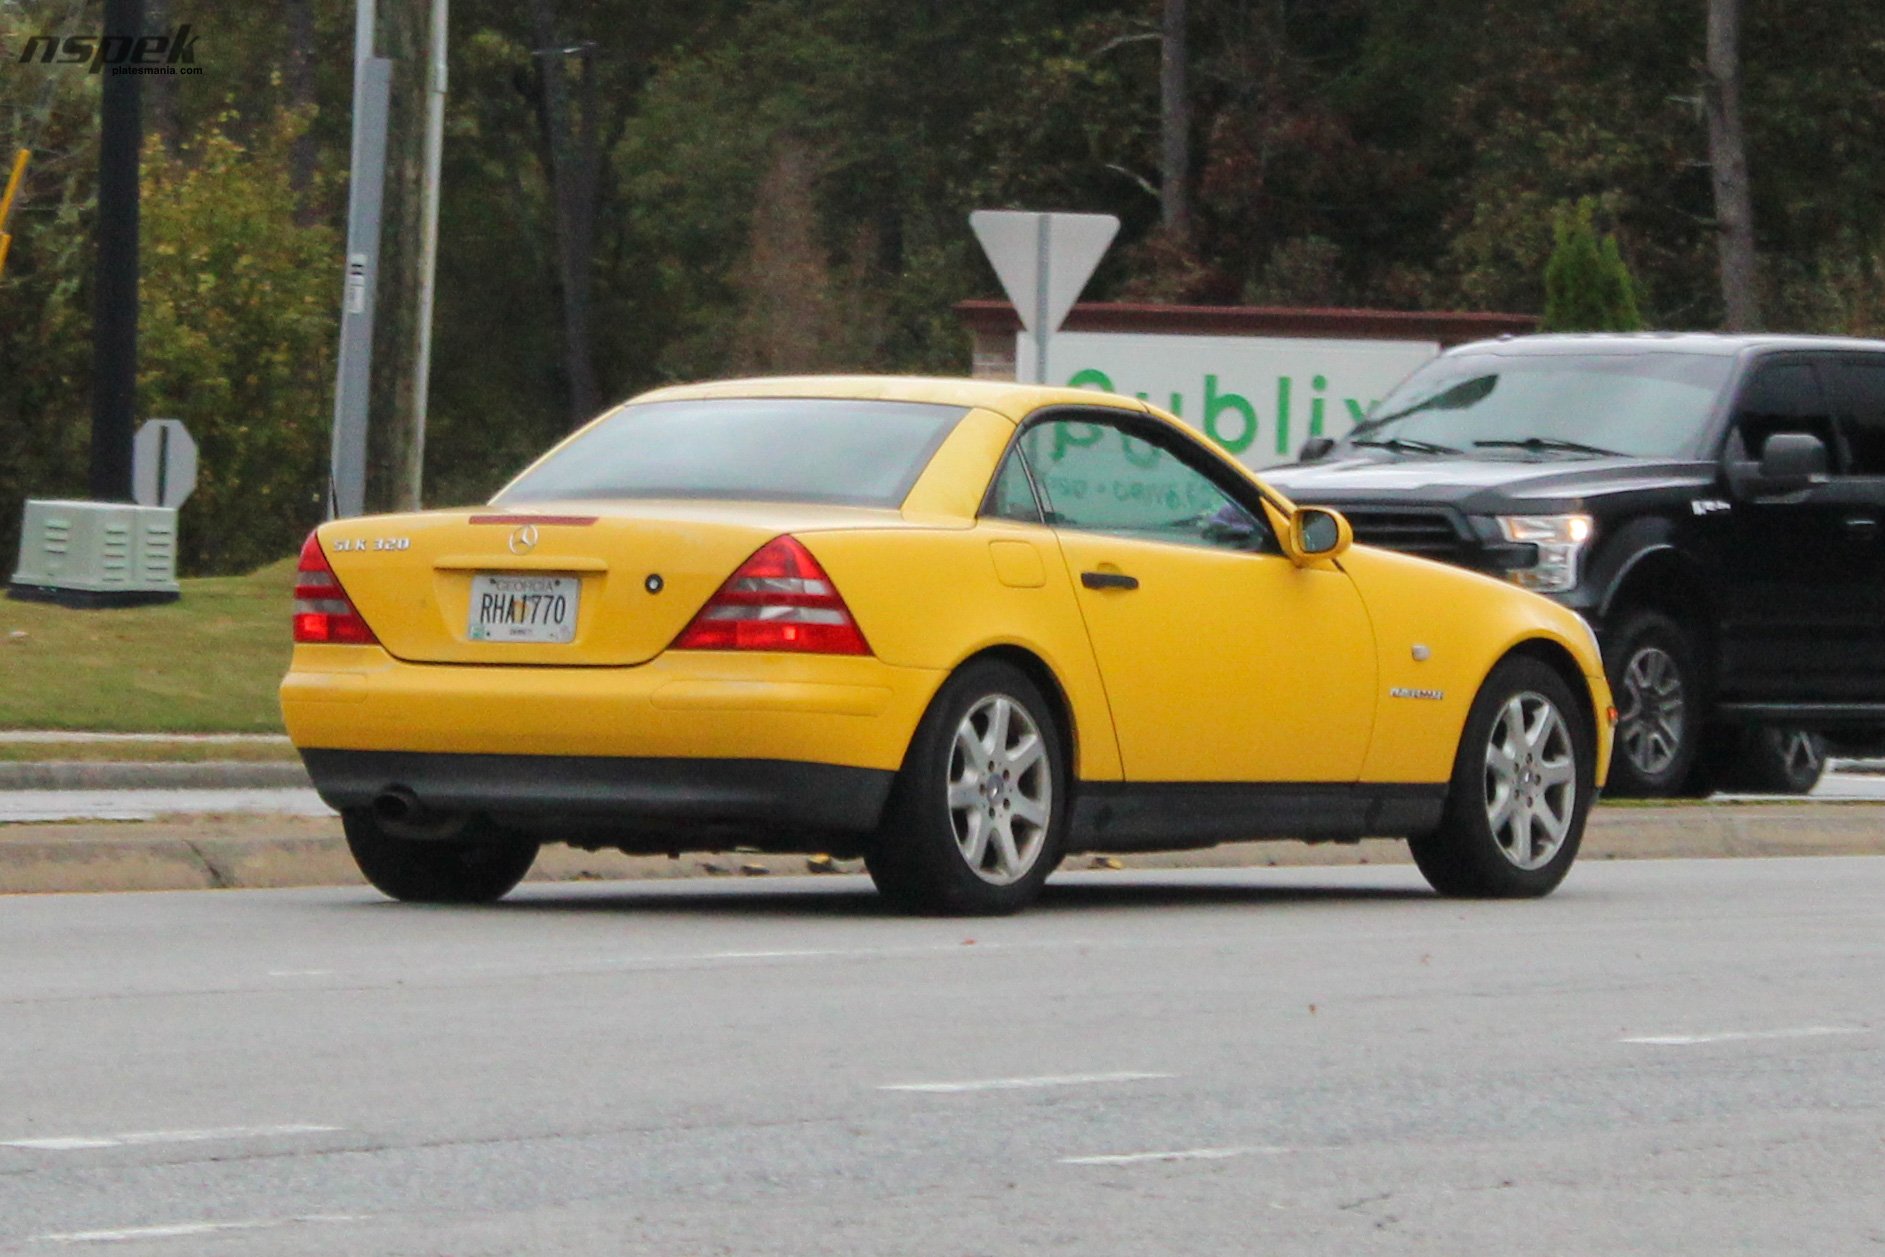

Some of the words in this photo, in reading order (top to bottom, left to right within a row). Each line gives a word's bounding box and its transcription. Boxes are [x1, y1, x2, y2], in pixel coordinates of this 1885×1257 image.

[334, 538, 366, 551] SLK
[373, 537, 411, 551] 320
[495, 580, 554, 592] GEORGIA
[480, 592, 566, 625] RHA1770
